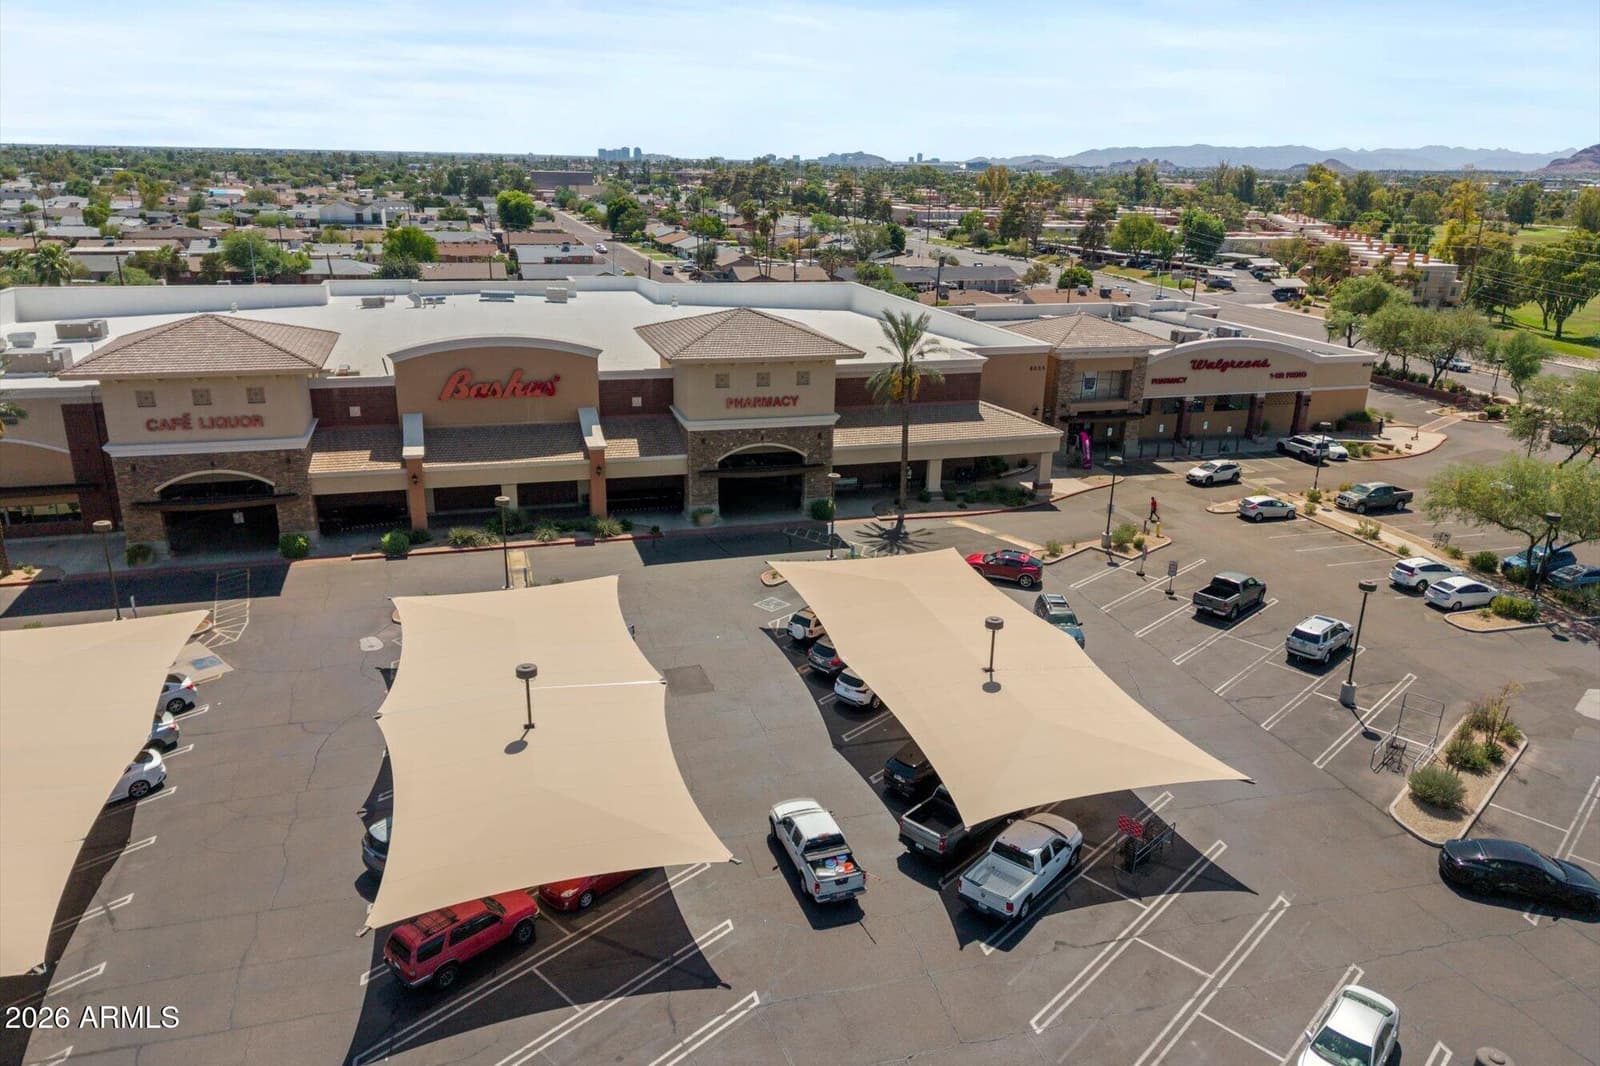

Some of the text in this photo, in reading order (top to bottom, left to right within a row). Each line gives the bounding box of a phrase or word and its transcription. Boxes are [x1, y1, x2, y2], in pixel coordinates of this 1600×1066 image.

[1190, 358, 1270, 372] Walgreens
[726, 395, 798, 409] PHARMACY
[145, 413, 264, 432] CAFÉ LIQUOR
